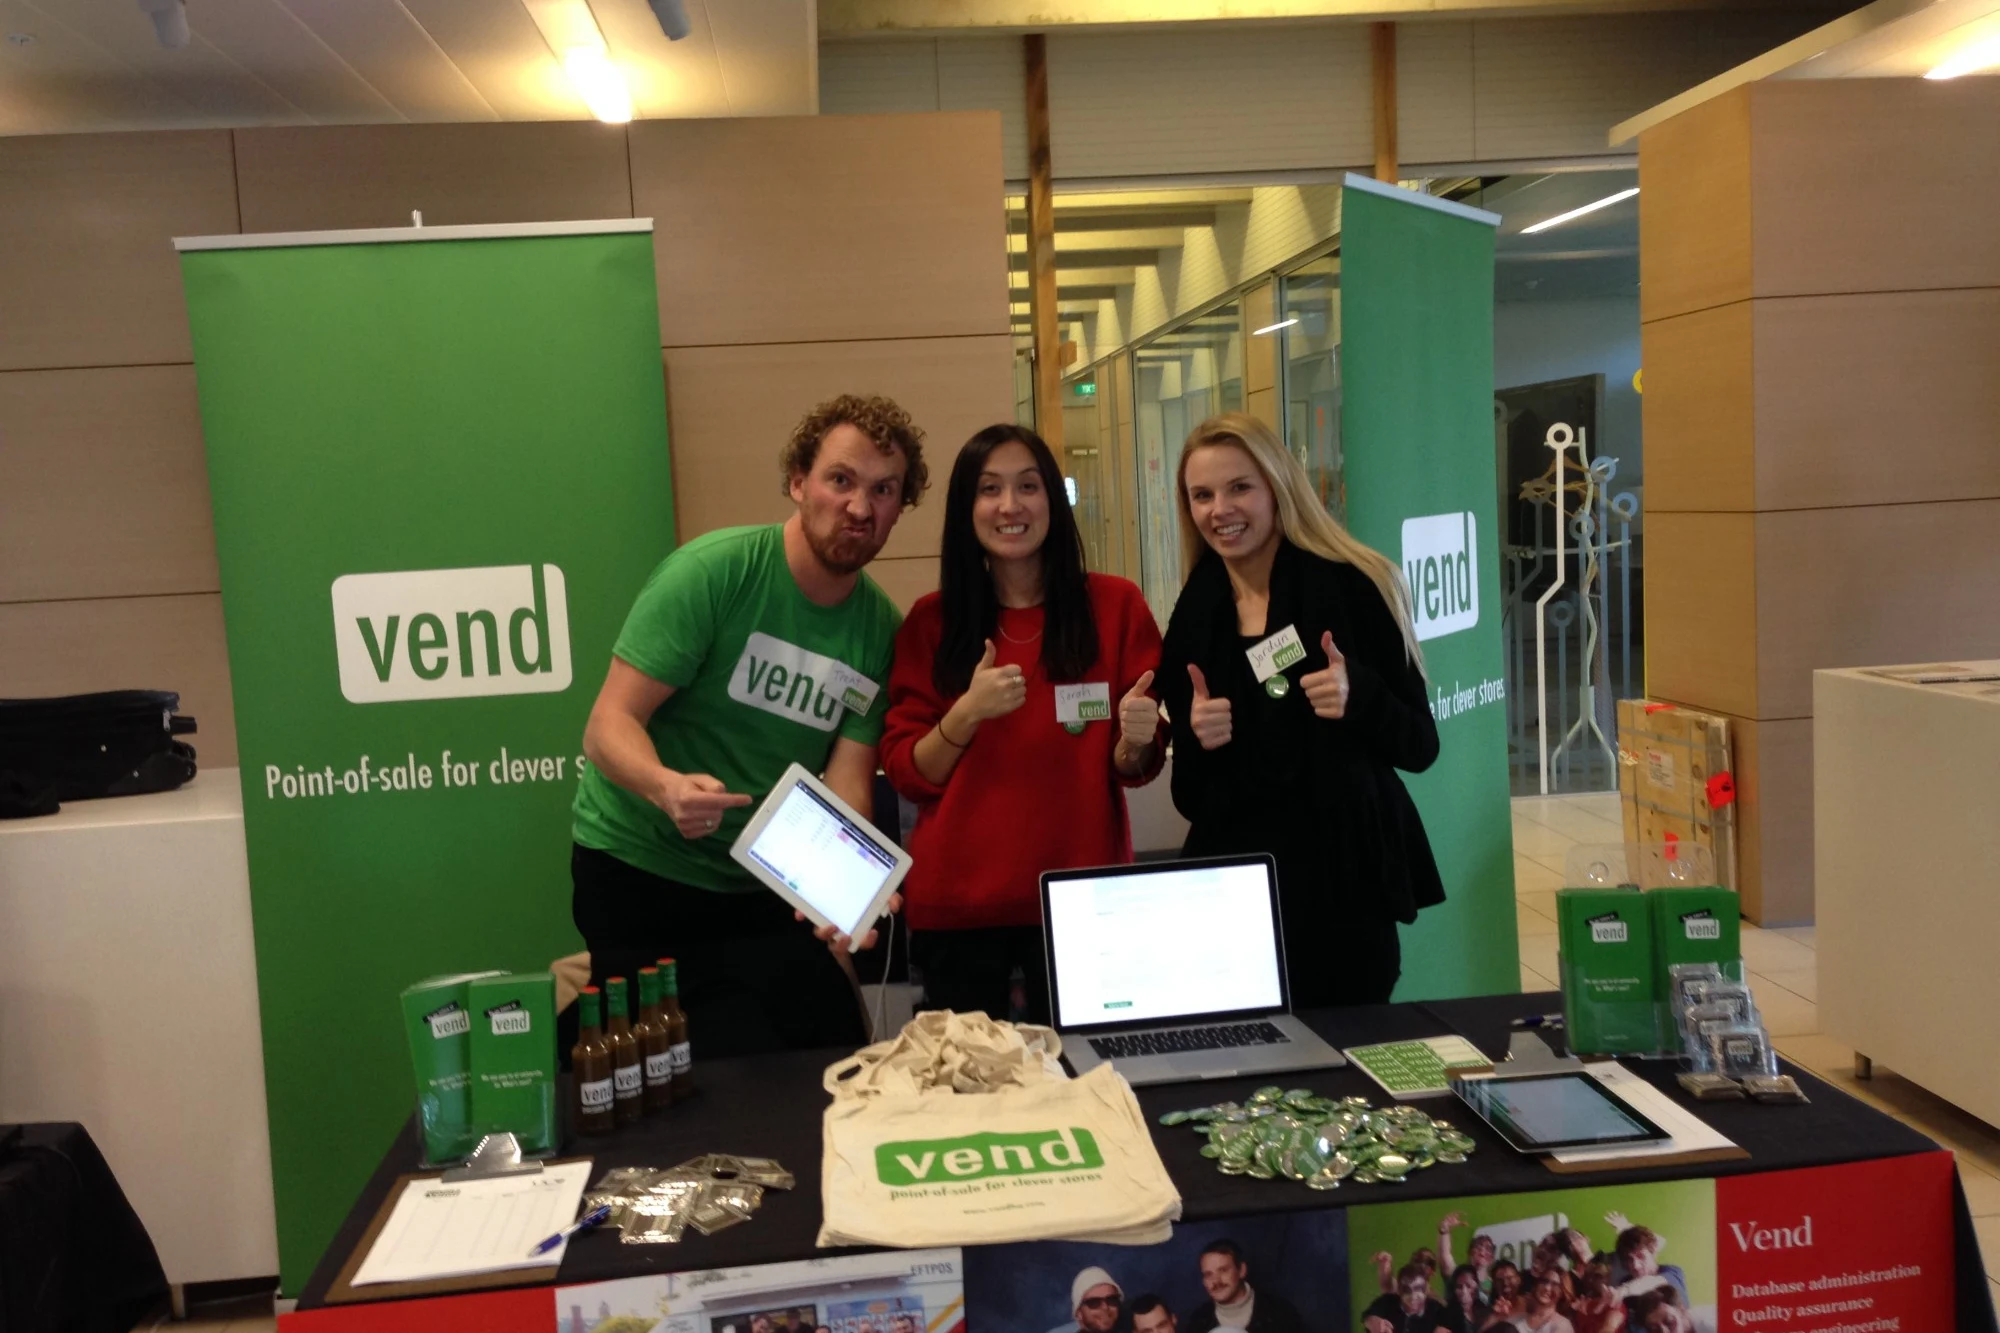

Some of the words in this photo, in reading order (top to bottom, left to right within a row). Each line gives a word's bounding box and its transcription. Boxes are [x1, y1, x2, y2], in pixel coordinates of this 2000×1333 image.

[1408, 512, 1472, 624] vend
[356, 564, 552, 683] vend
[1276, 640, 1301, 666] vend
[1081, 700, 1108, 718] vend
[1437, 686, 1451, 720] for
[1453, 680, 1476, 715] clever
[1479, 678, 1505, 705] stores
[265, 753, 433, 799] Point-of-sale
[441, 750, 479, 787] for
[489, 747, 566, 784] clever
[1596, 922, 1625, 939] vend
[1689, 919, 1717, 936] vend
[436, 1010, 467, 1034] vend
[495, 1010, 527, 1031] vend
[895, 1128, 1085, 1180] vend
[986, 1181, 1006, 1192] for
[1012, 1176, 1054, 1187] clever
[1060, 1173, 1104, 1184] stores
[1729, 1215, 1813, 1252] Vend
[911, 1262, 953, 1277] EFTPOS
[1732, 1281, 1806, 1299] Database
[1808, 1264, 1921, 1291] administration
[1733, 1305, 1794, 1327] Quality
[1796, 1297, 1874, 1317] assurance
